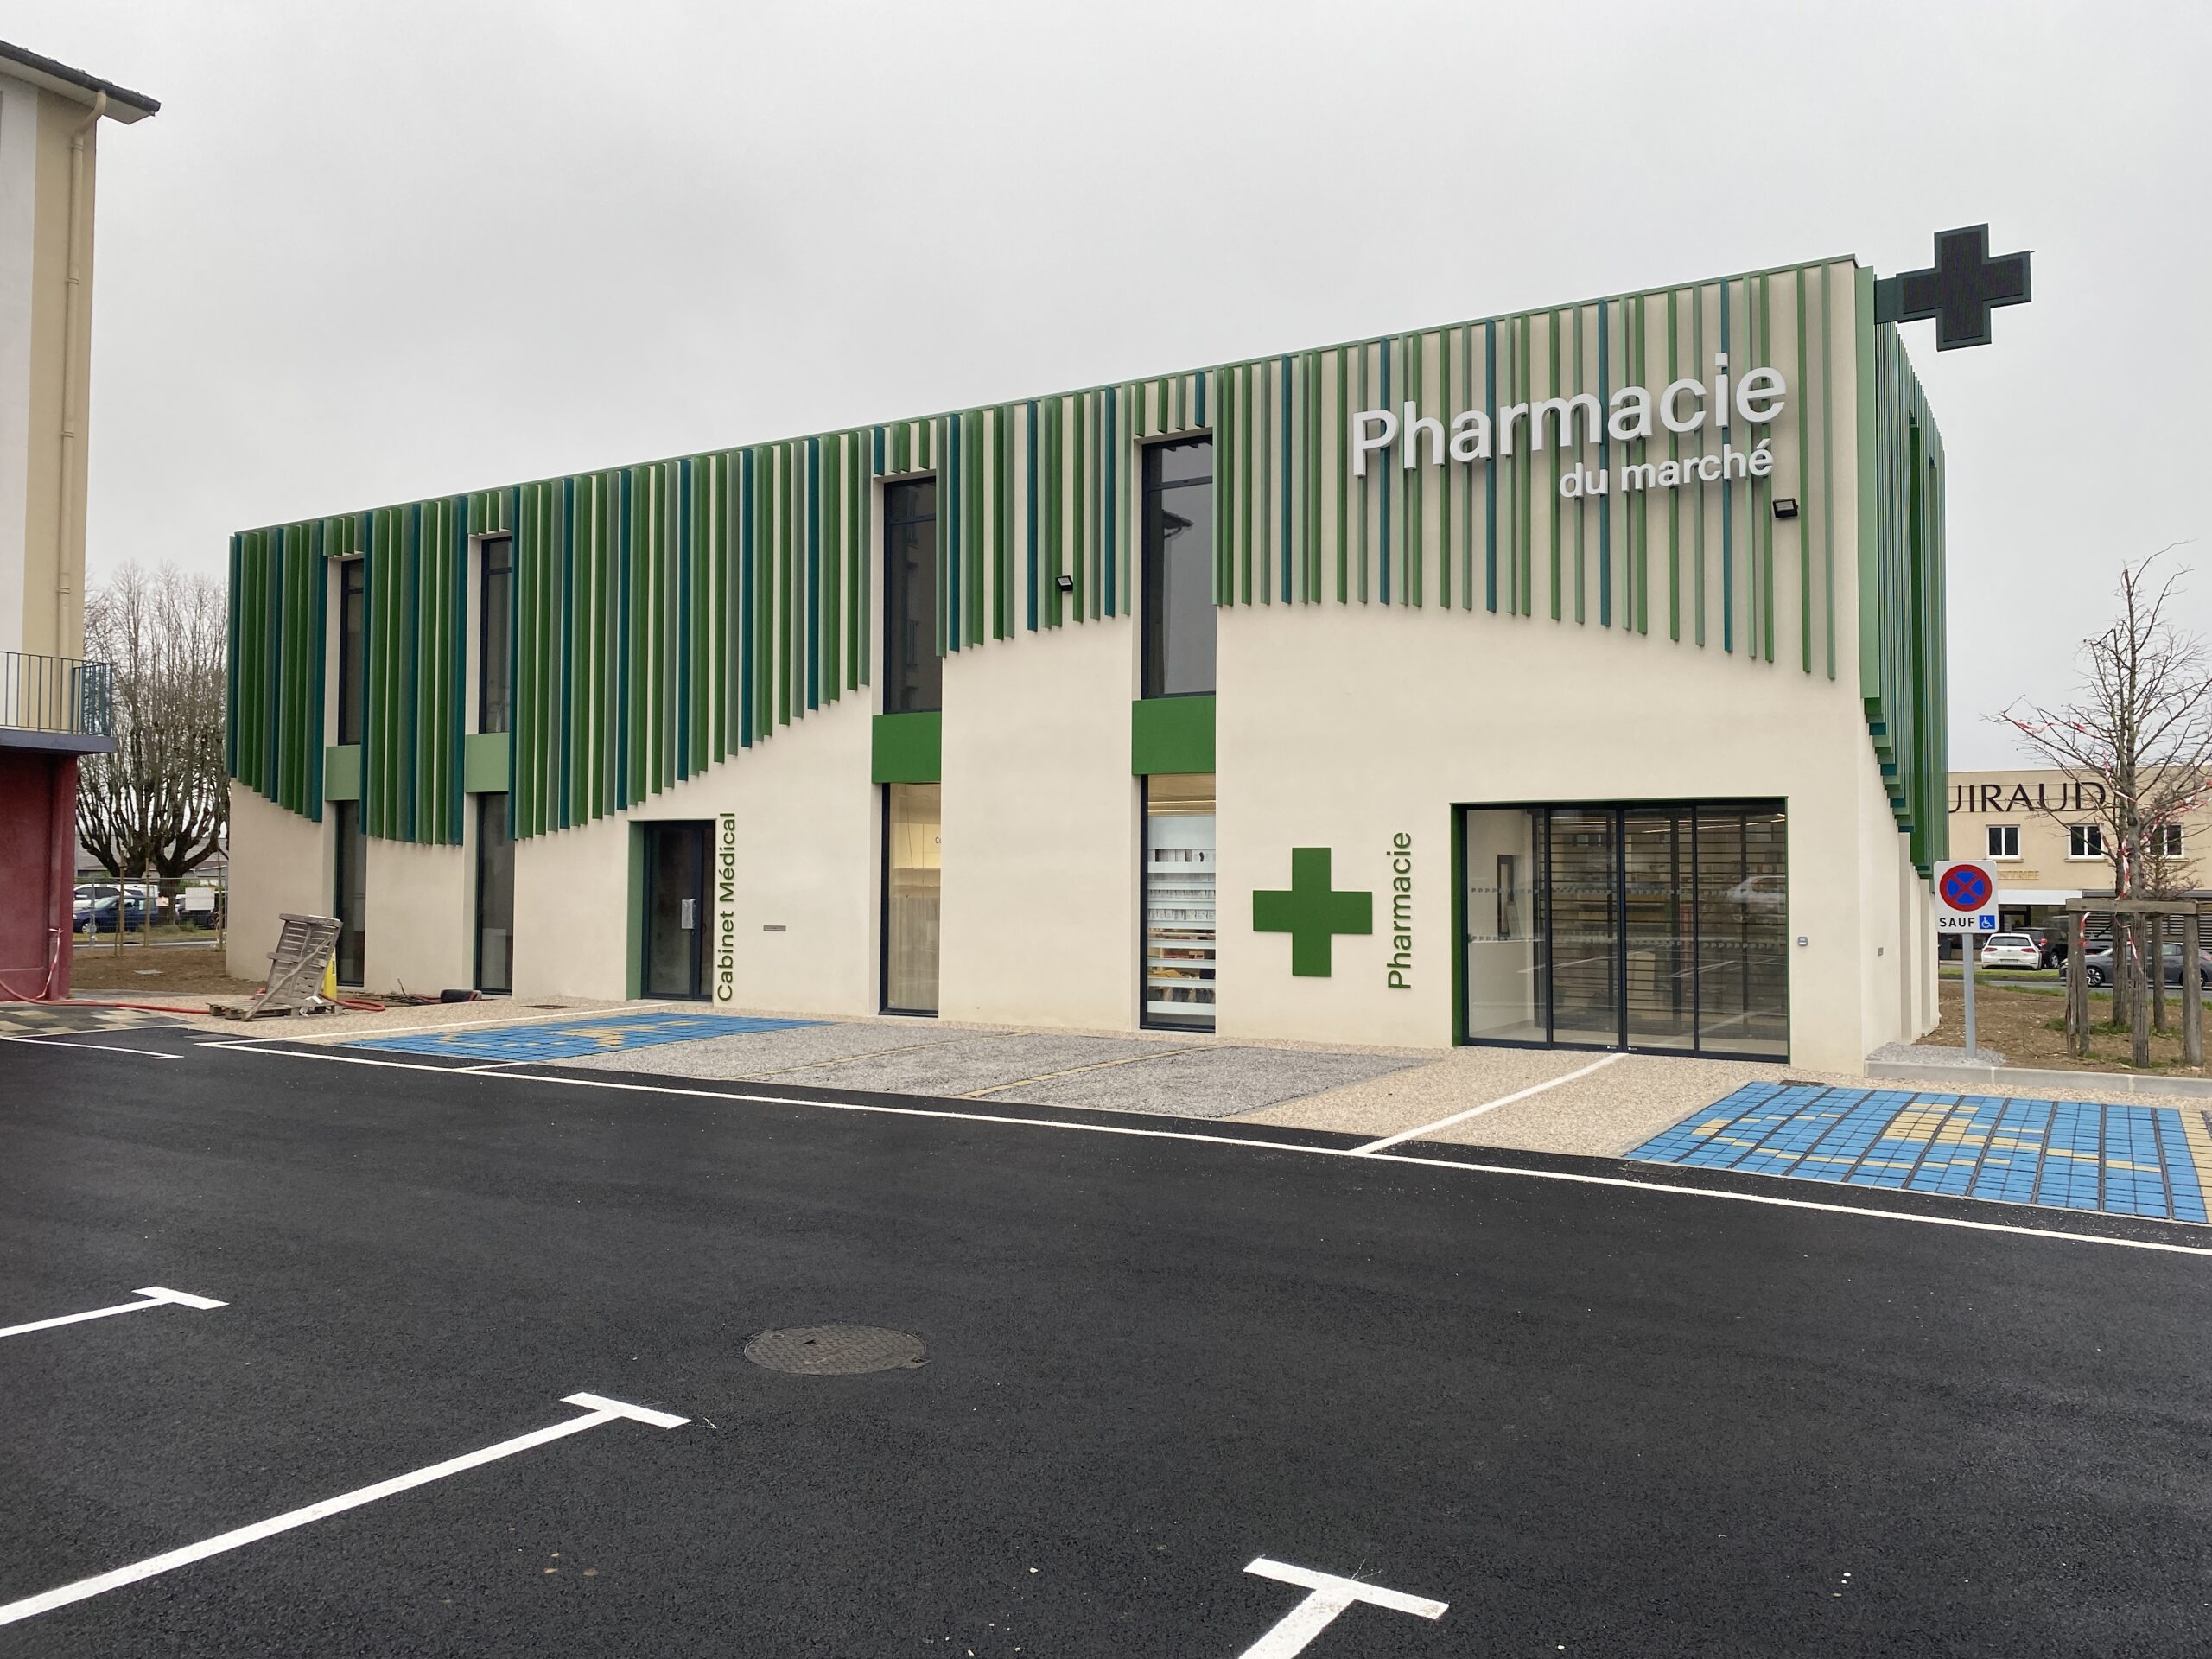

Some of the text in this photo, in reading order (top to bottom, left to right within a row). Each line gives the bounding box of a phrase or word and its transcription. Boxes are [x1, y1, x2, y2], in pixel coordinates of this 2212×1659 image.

[1352, 352, 1787, 477] Pharmacie
[1559, 438, 1774, 498] du marché
[717, 812, 735, 1001] Cabinet Médical
[1386, 832, 1412, 989] Pharmacie
[1939, 917, 1975, 927] SAUF
